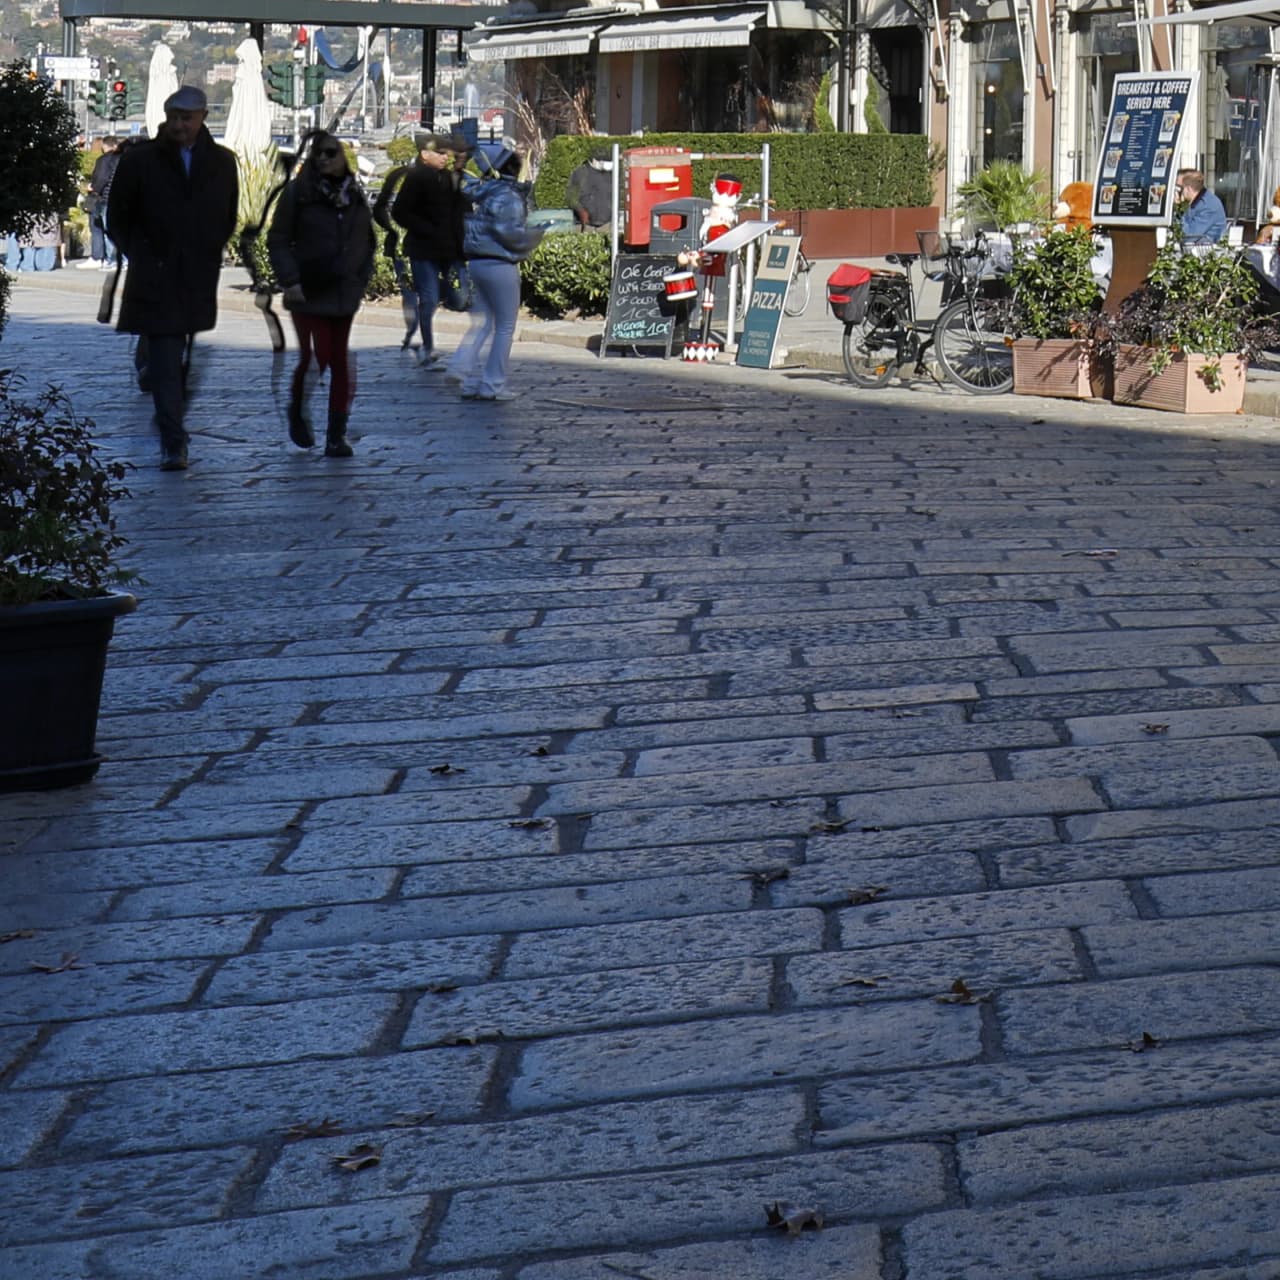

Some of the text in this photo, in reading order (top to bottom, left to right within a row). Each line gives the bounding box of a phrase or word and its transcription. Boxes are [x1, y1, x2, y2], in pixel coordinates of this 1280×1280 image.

[1118, 82, 1155, 96] BREAKFAST
[1161, 80, 1189, 94] COFFEE
[1126, 96, 1172, 110] SERVED HERE
[751, 291, 782, 310] PIZZA
